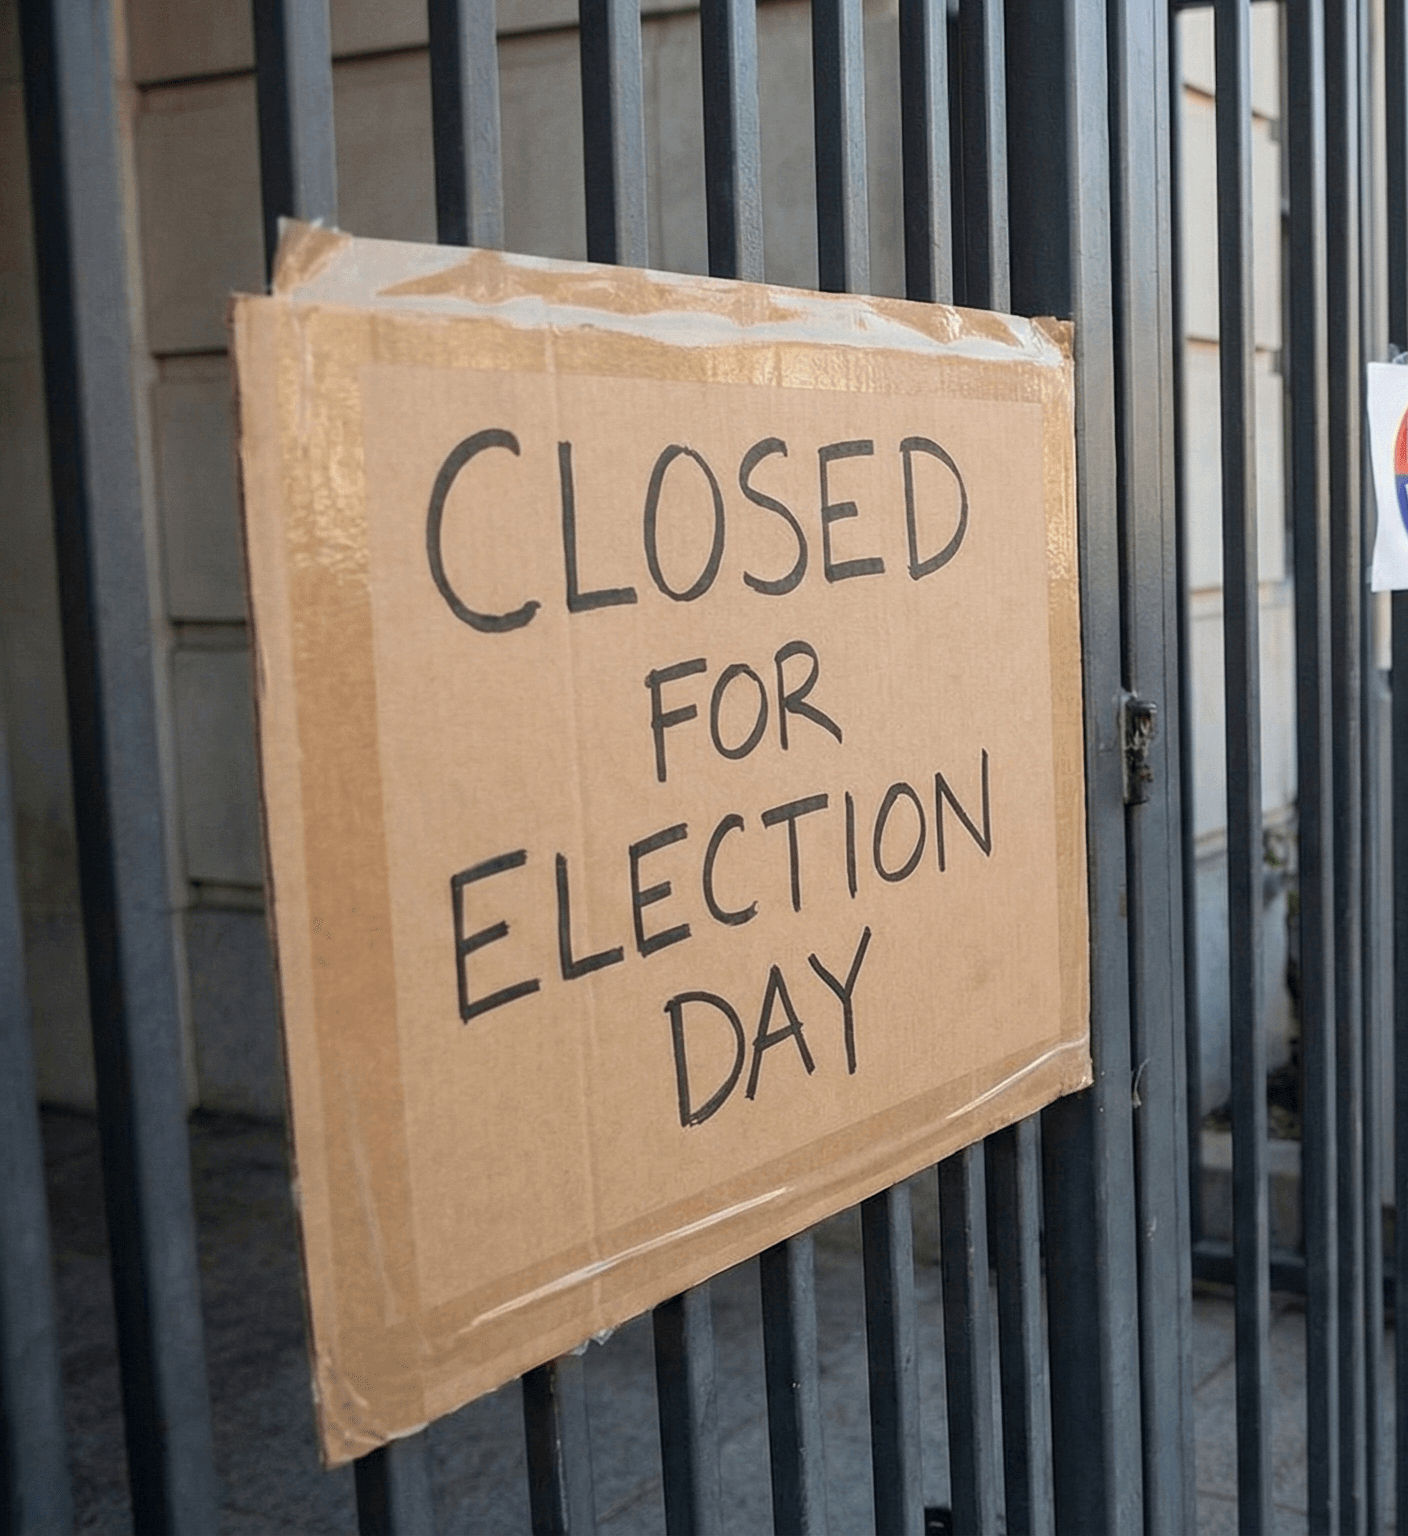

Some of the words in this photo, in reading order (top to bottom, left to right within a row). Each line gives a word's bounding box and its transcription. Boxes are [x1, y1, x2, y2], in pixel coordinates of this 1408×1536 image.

[426, 429, 968, 633] CLOSED
[645, 641, 842, 782] FOR
[451, 749, 991, 1023] ELECTION
[665, 927, 871, 1127] DAY
